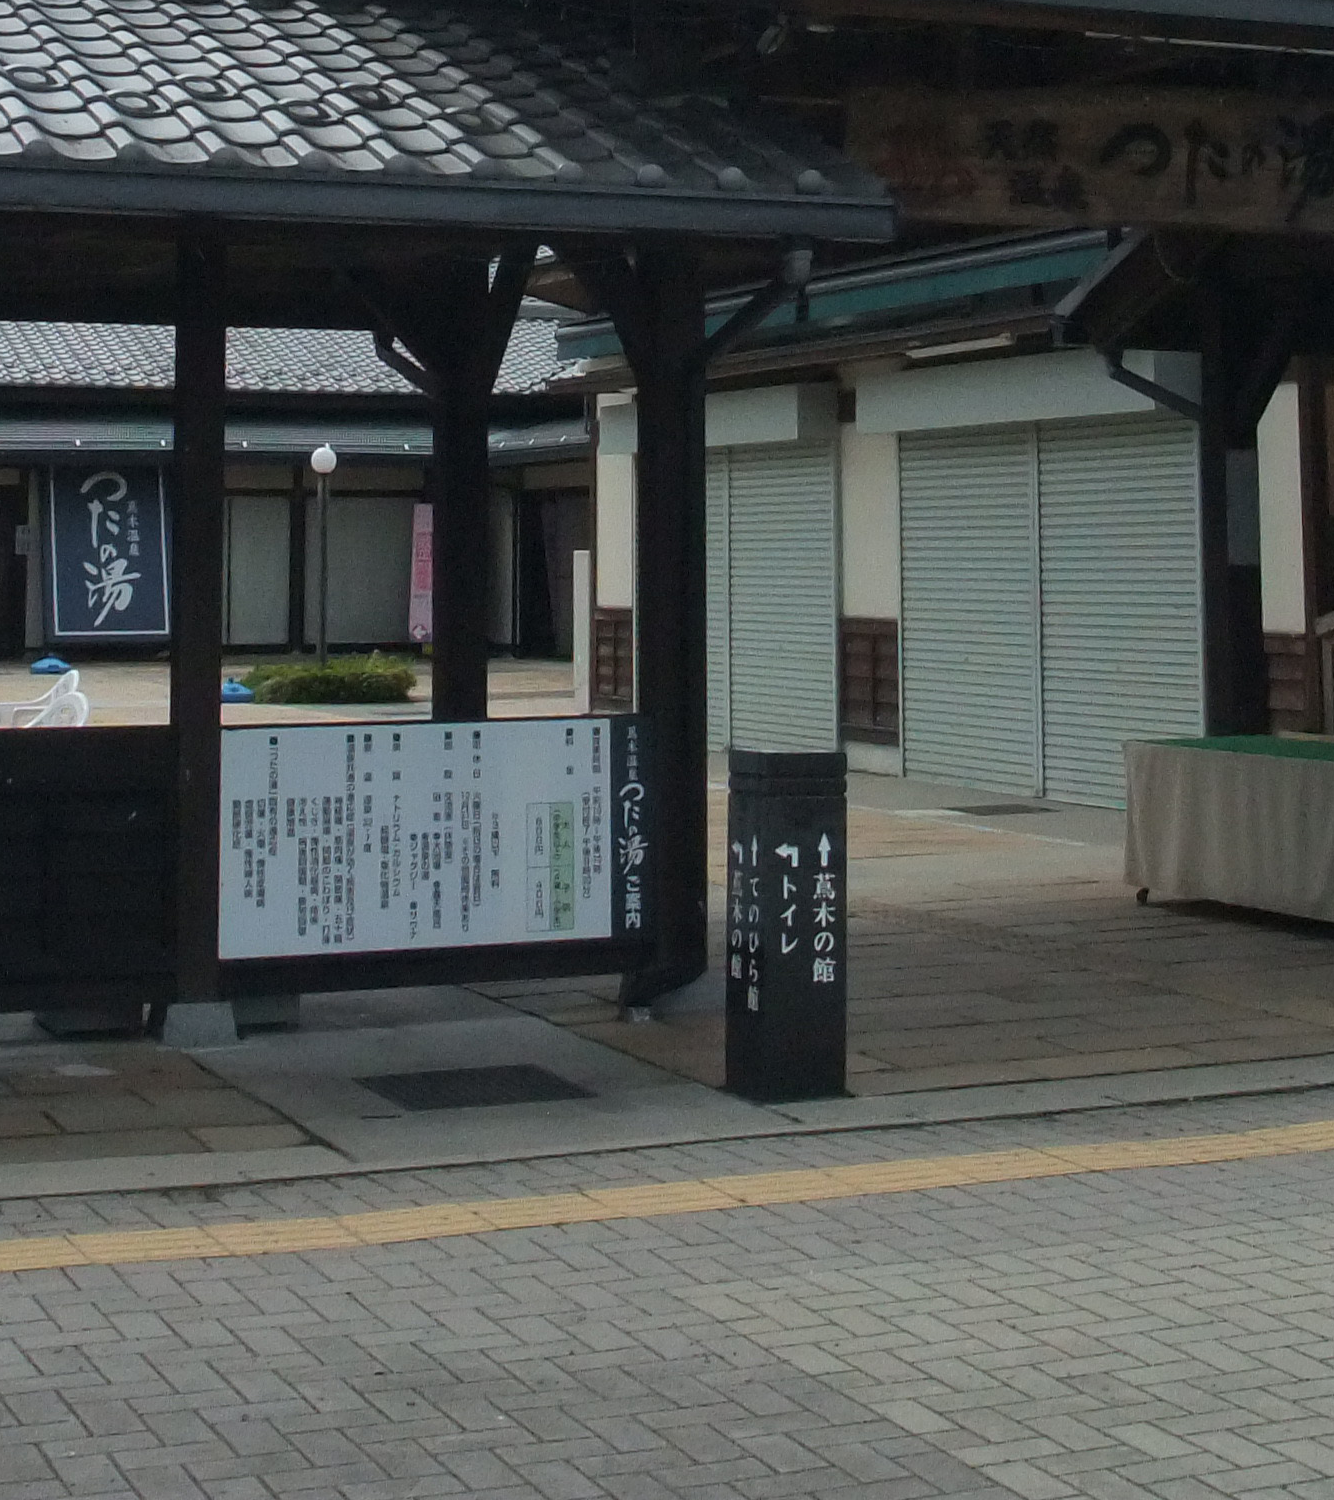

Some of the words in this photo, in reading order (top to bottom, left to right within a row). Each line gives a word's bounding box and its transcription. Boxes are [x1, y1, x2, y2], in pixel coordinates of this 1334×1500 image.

[79, 471, 142, 627] つたの湯
[747, 877, 760, 1012] てのひら館
[780, 875, 799, 954] トイレ
[812, 873, 836, 983] 蔦木の館
